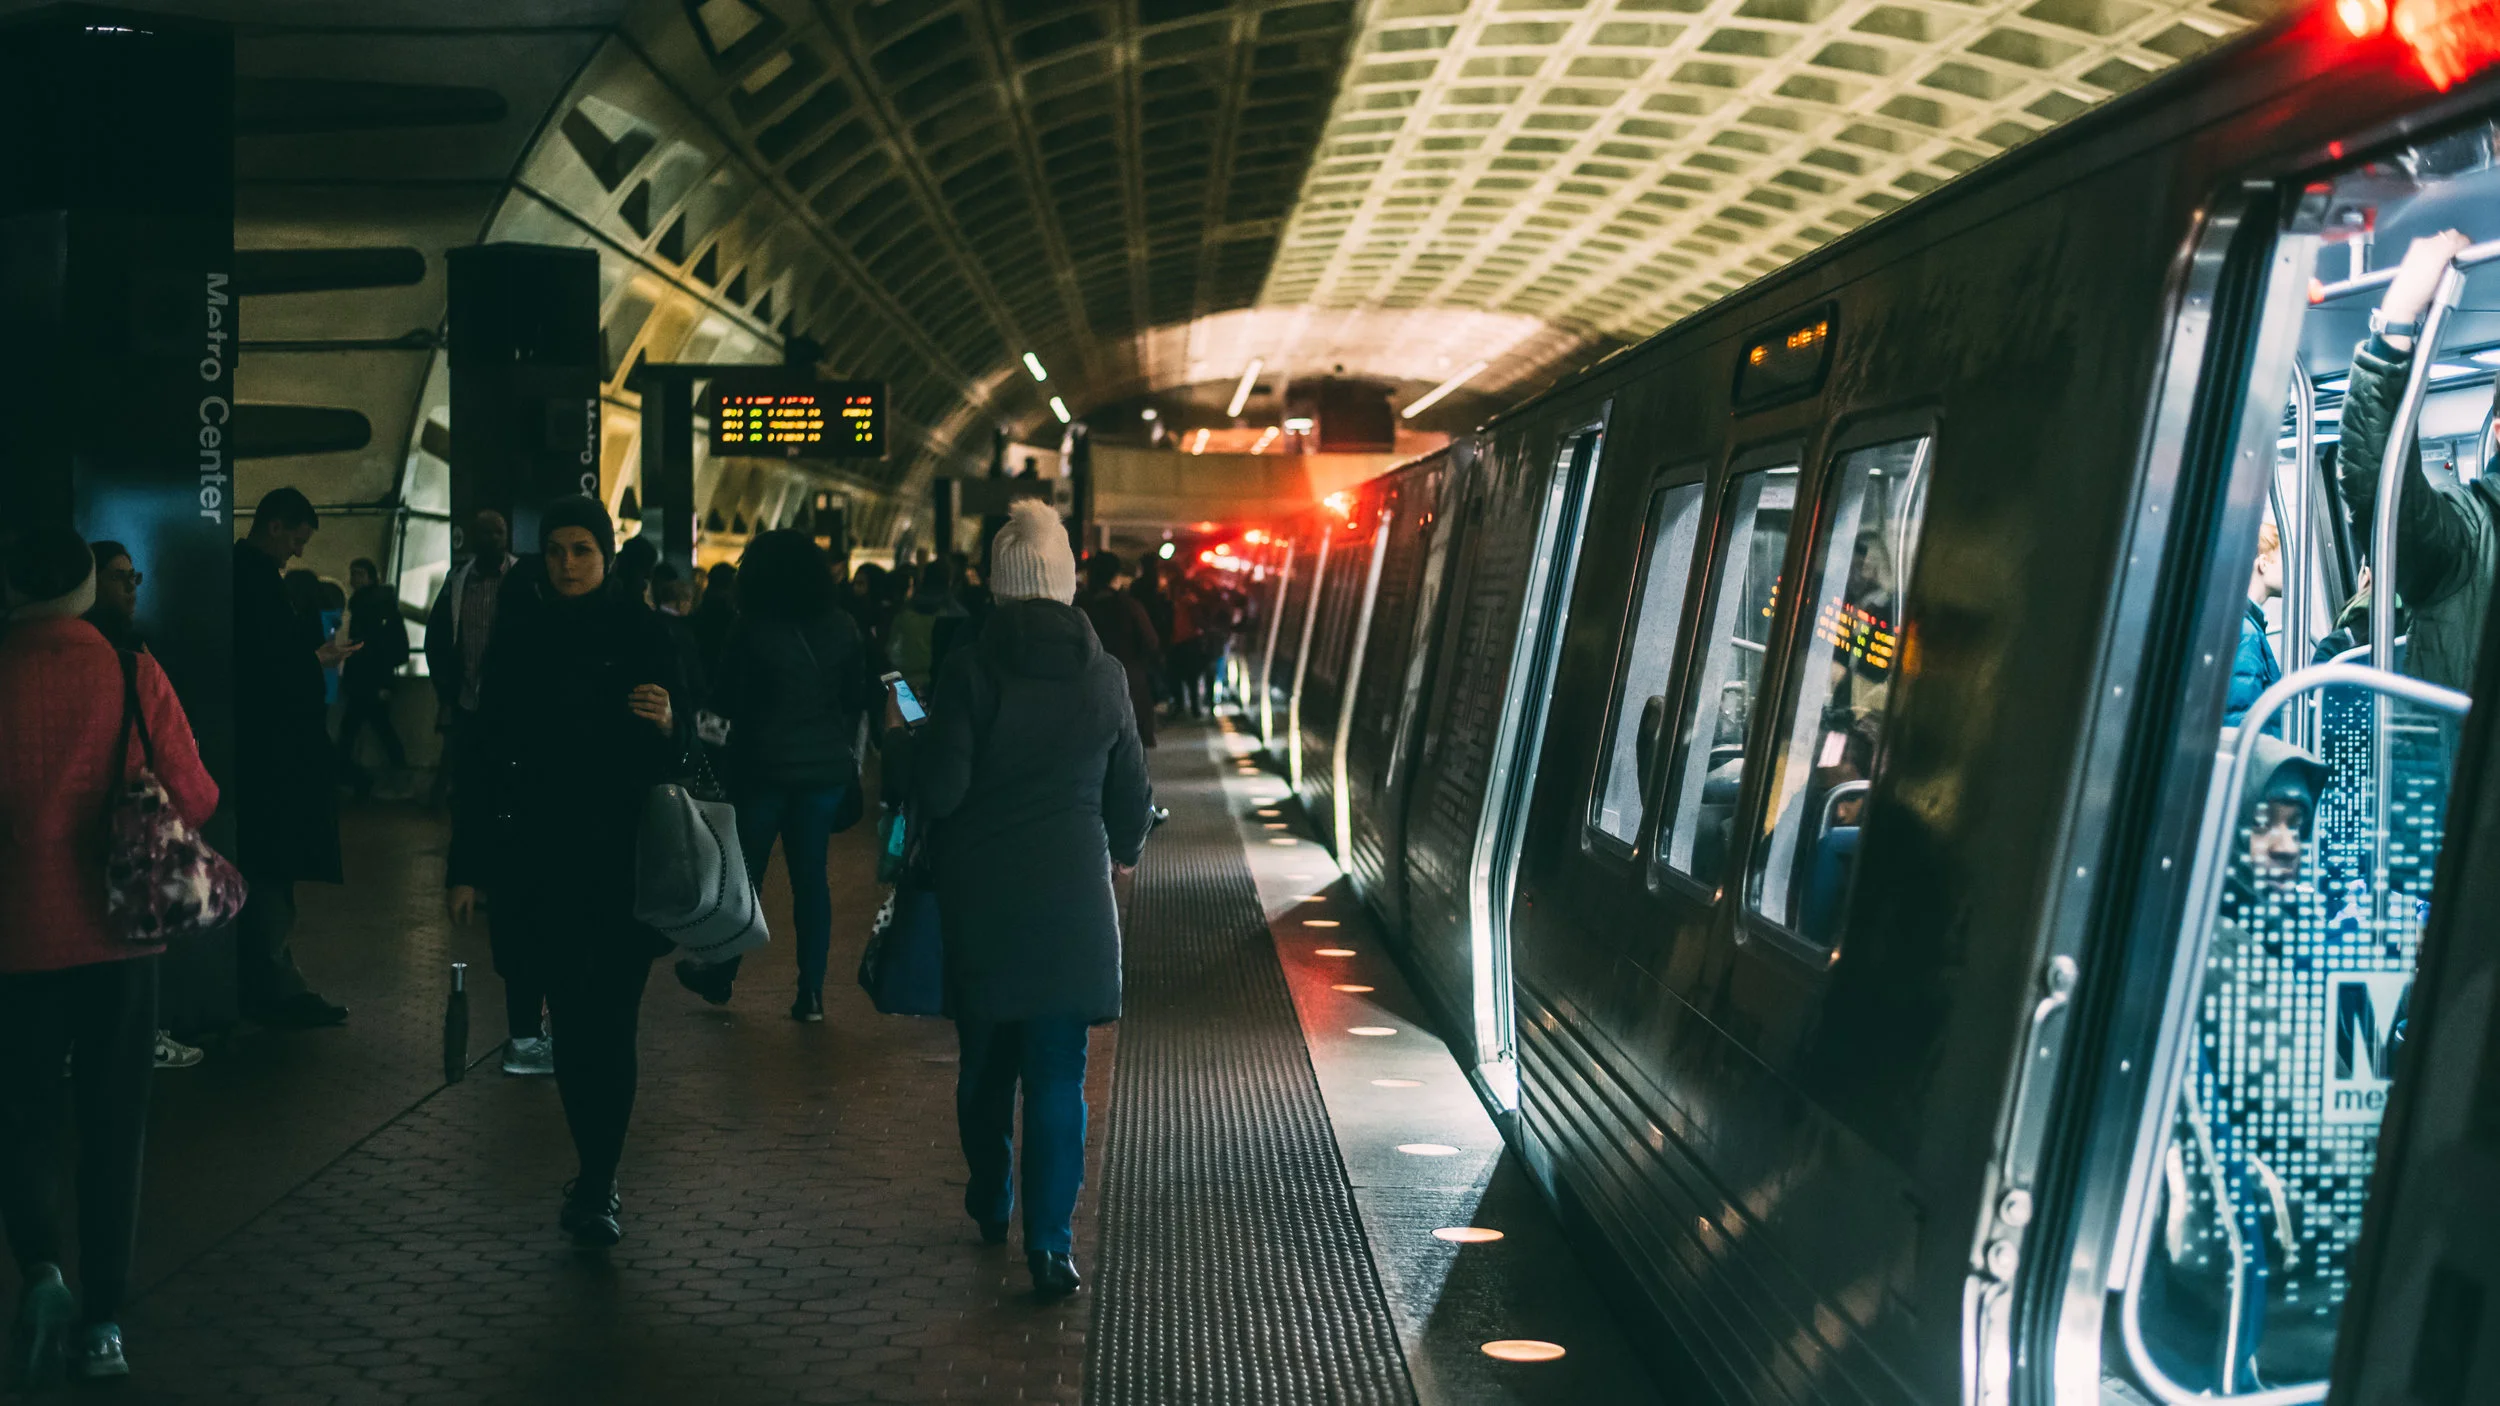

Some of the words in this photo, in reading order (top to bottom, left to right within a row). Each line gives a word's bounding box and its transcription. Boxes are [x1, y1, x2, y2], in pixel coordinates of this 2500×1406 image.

[200, 272, 229, 382] Metro
[200, 396, 230, 524] Center
[2334, 1088, 2388, 1111] me
